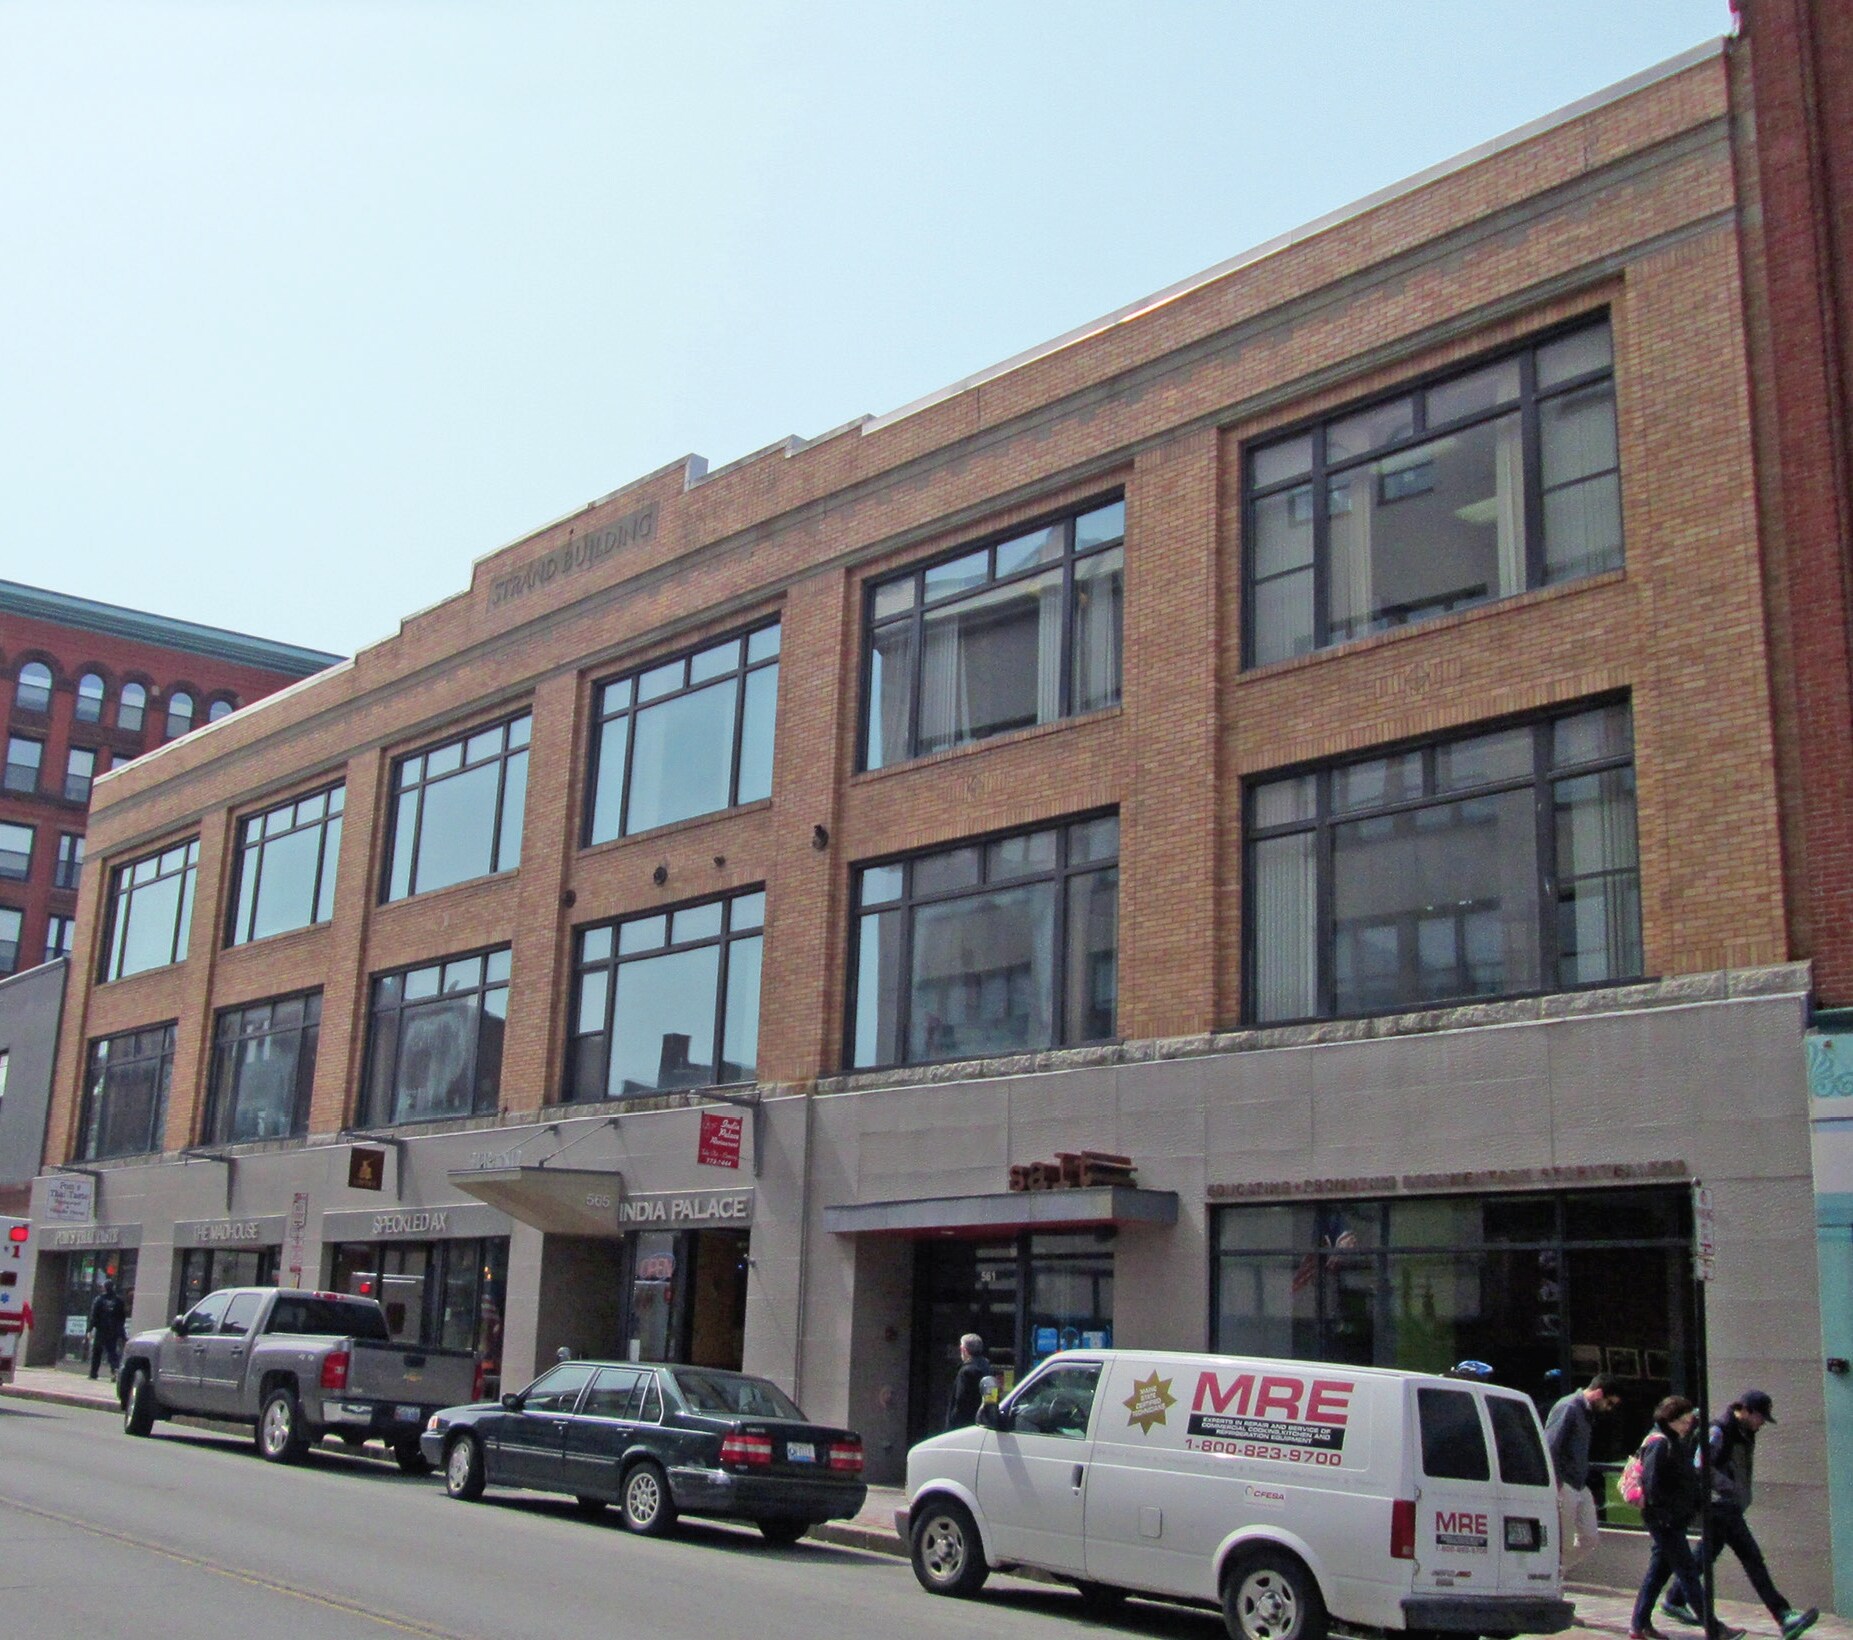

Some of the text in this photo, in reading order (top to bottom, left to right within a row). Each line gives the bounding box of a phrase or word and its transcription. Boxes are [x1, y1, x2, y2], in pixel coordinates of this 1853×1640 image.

[492, 511, 653, 605] STRAND BUILDING
[619, 1197, 748, 1222] INDIA PALACE
[372, 1211, 447, 1233] SPECKLED AX
[980, 1271, 997, 1282] 561
[1191, 1371, 1355, 1425] MRE
[1201, 1422, 1247, 1432] COMMERCIAL
[1314, 1432, 1331, 1440] AND
[1202, 1416, 1234, 1425] EXPERTS
[1244, 1420, 1270, 1429] REPAIR
[1288, 1425, 1320, 1434] SERVICE
[1216, 1429, 1313, 1444] REFRIGERATION EQUIPMENT
[1185, 1438, 1342, 1467] 1-800-823-9700
[1436, 1511, 1488, 1535] MRE
